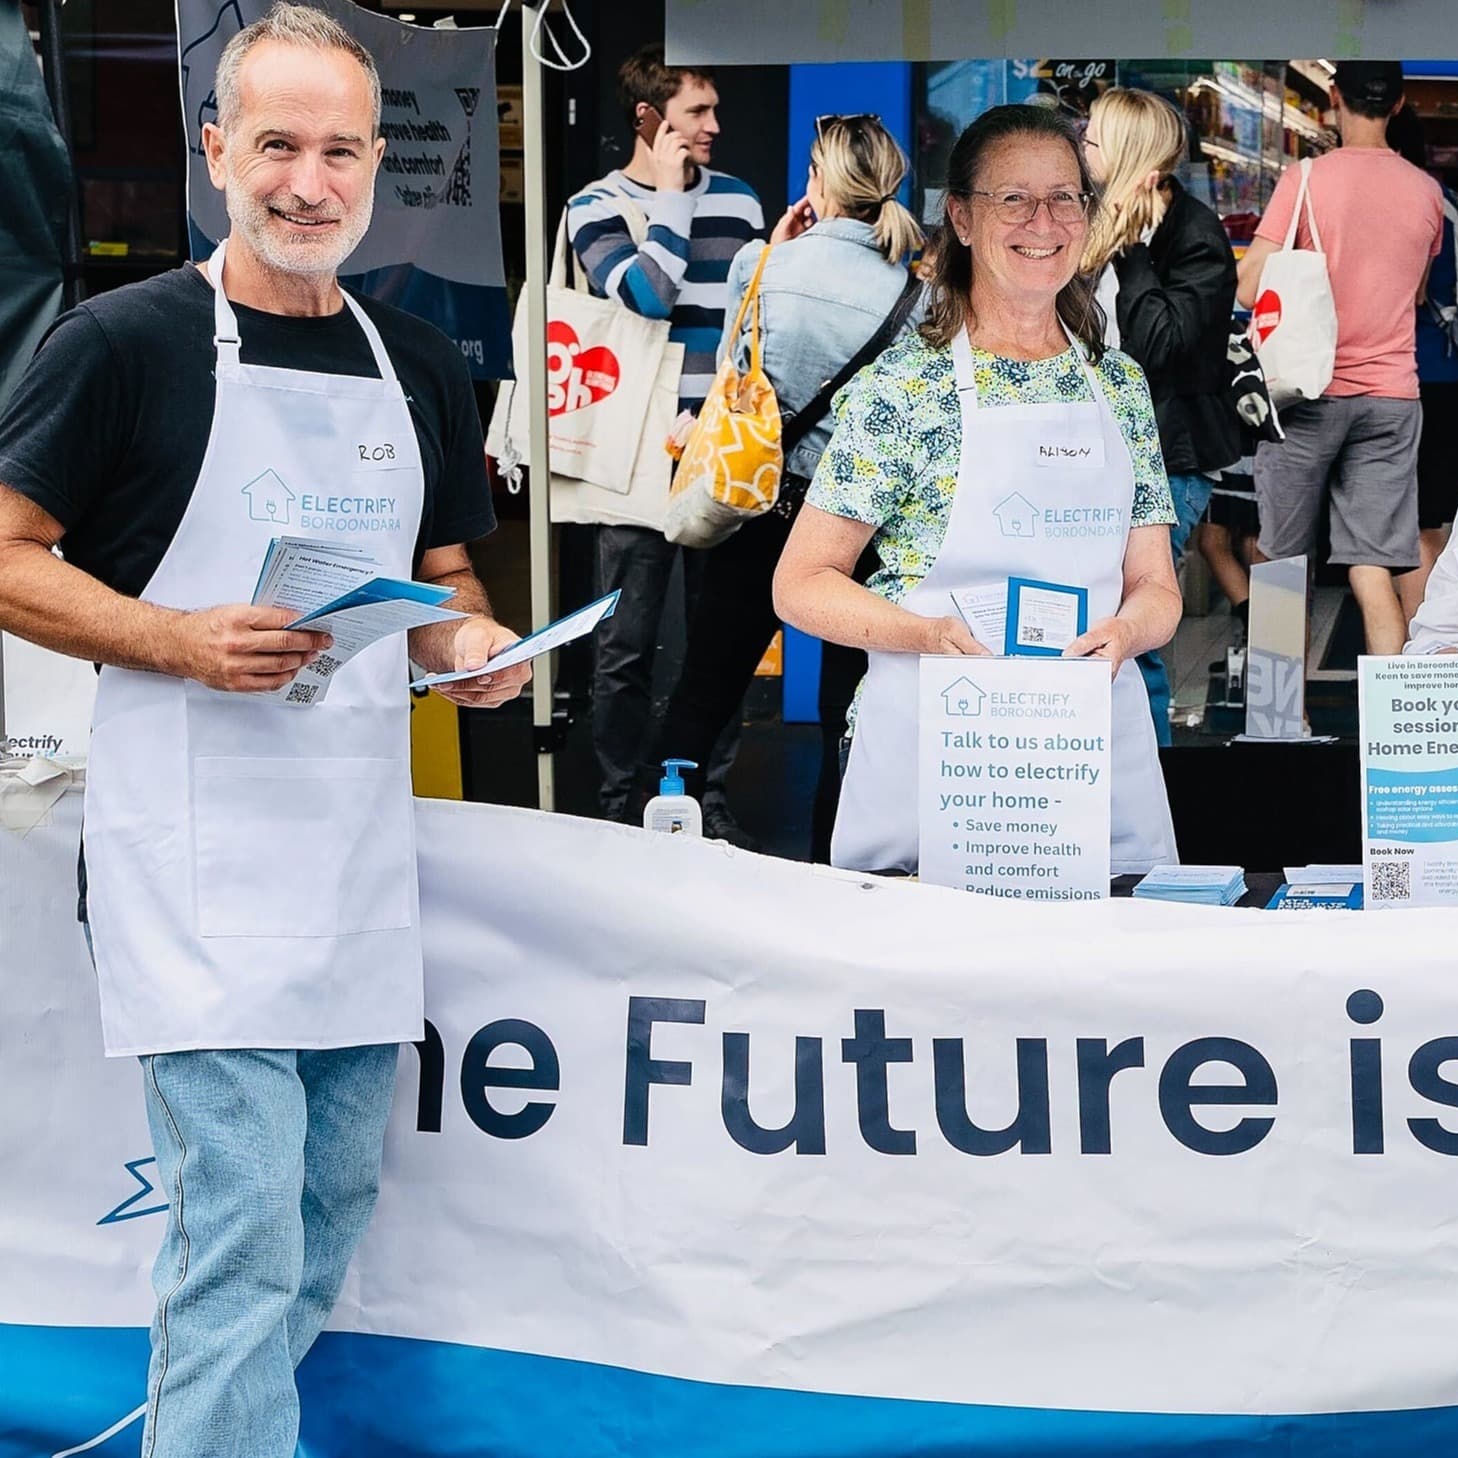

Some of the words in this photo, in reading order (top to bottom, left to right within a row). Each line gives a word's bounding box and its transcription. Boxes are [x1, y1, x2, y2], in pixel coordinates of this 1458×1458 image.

[358, 444, 395, 461] ROB
[302, 495, 395, 514] ELECTRIFY
[1044, 508, 1123, 523] ELECTRIFY
[301, 516, 400, 532] BOROONDARA
[1044, 525, 1124, 538] BOROONDAR
[1375, 672, 1398, 680] Keen
[1400, 672, 1409, 680] to
[1404, 681, 1442, 690] improve
[990, 692, 1070, 706] ELECTRIFY
[1391, 697, 1437, 712] Book
[990, 707, 1077, 719] BOROONDARA
[8, 734, 63, 753] ectrify
[941, 731, 983, 749] Talk
[988, 733, 1009, 749] to
[1015, 736, 1038, 751] us
[1044, 733, 1105, 751] about
[1367, 741, 1423, 756] Home
[941, 760, 983, 778] how
[987, 763, 1009, 779] to
[1015, 763, 1100, 785] electrify
[1369, 785, 1391, 794] Free
[1391, 784, 1428, 796] energy
[939, 794, 987, 811] your
[992, 791, 1049, 809] home
[966, 819, 1001, 832] Save
[1006, 821, 1058, 837] money
[966, 841, 1029, 857] Improve
[1033, 842, 1082, 857] health
[1370, 848, 1393, 856] Book
[1394, 847, 1415, 855] Now
[965, 863, 993, 876] and
[998, 864, 1060, 878] comfort
[966, 884, 1022, 899] Reduce
[1026, 886, 1101, 901] emissions
[622, 995, 1279, 1158] Future
